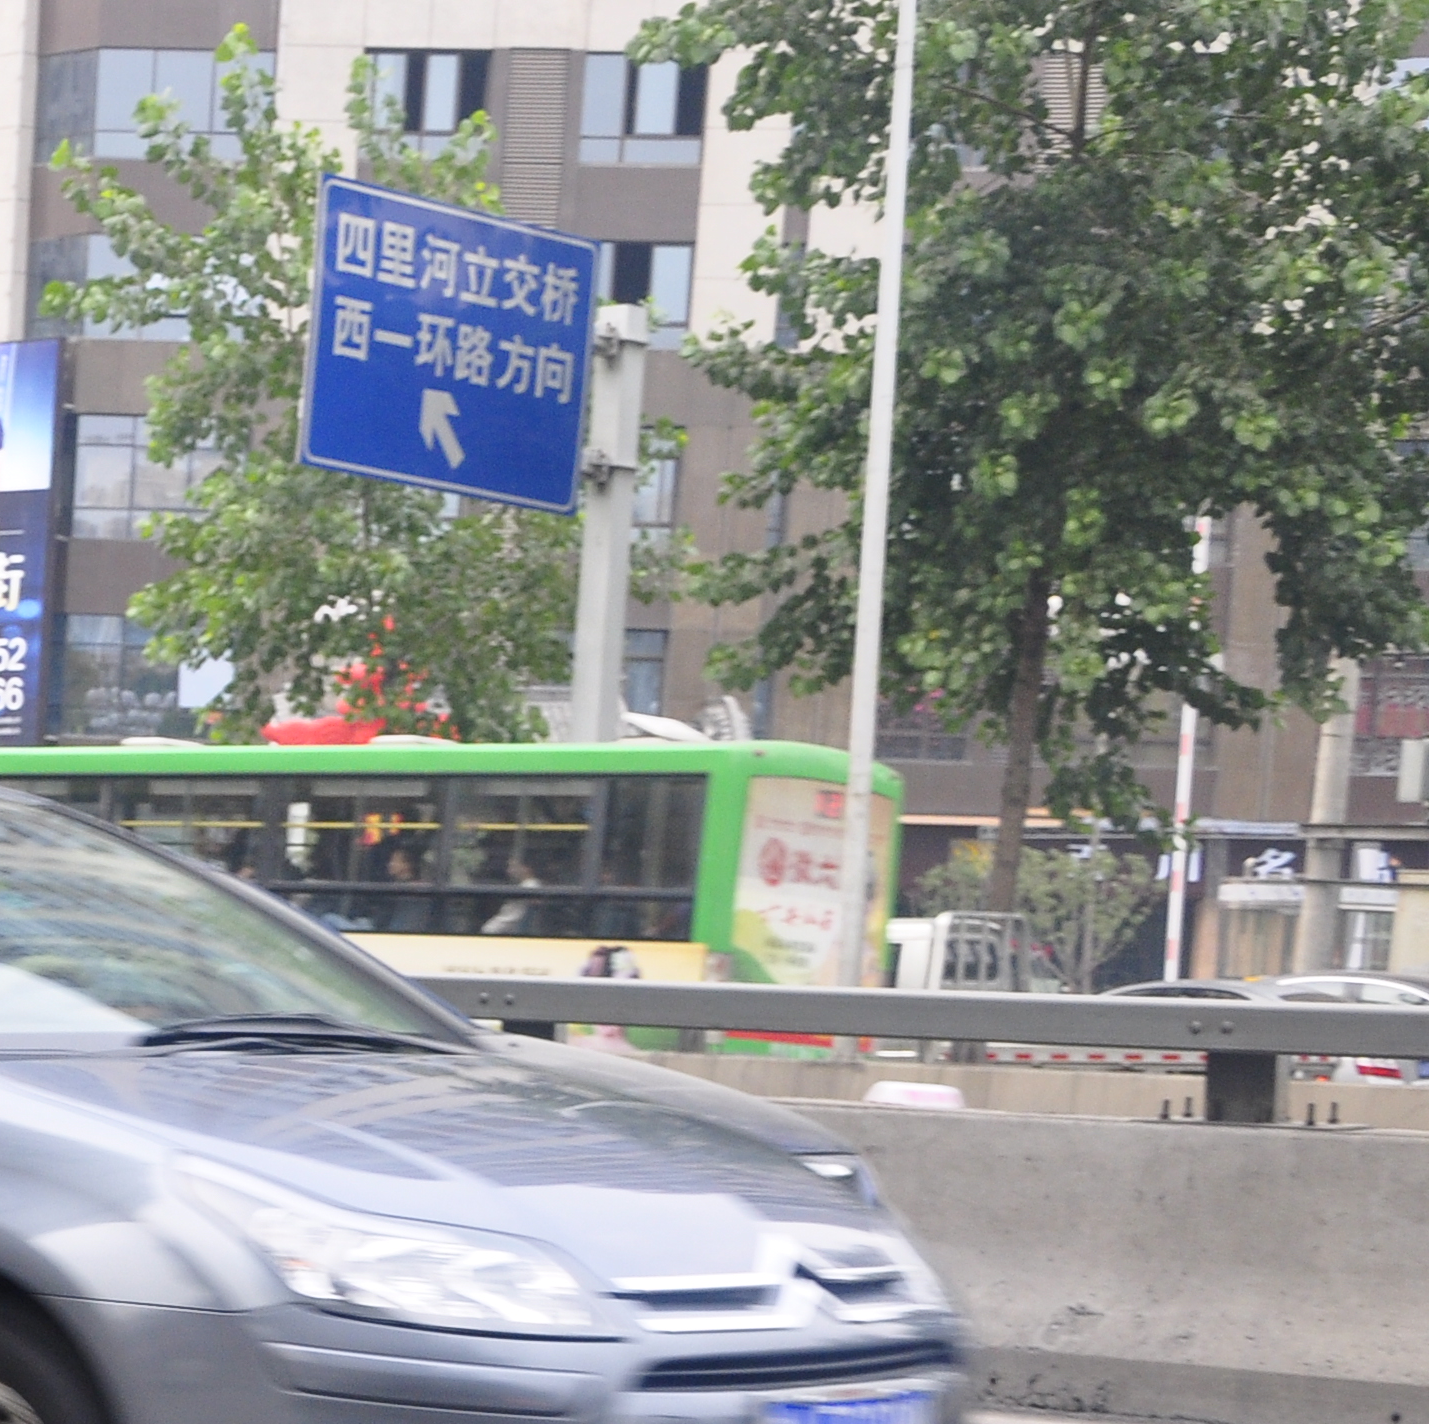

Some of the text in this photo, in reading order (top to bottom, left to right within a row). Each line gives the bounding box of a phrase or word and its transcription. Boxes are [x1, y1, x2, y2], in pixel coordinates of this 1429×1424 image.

[335, 213, 578, 325] 四里河立交桥
[332, 296, 575, 404] 西一环路方向
